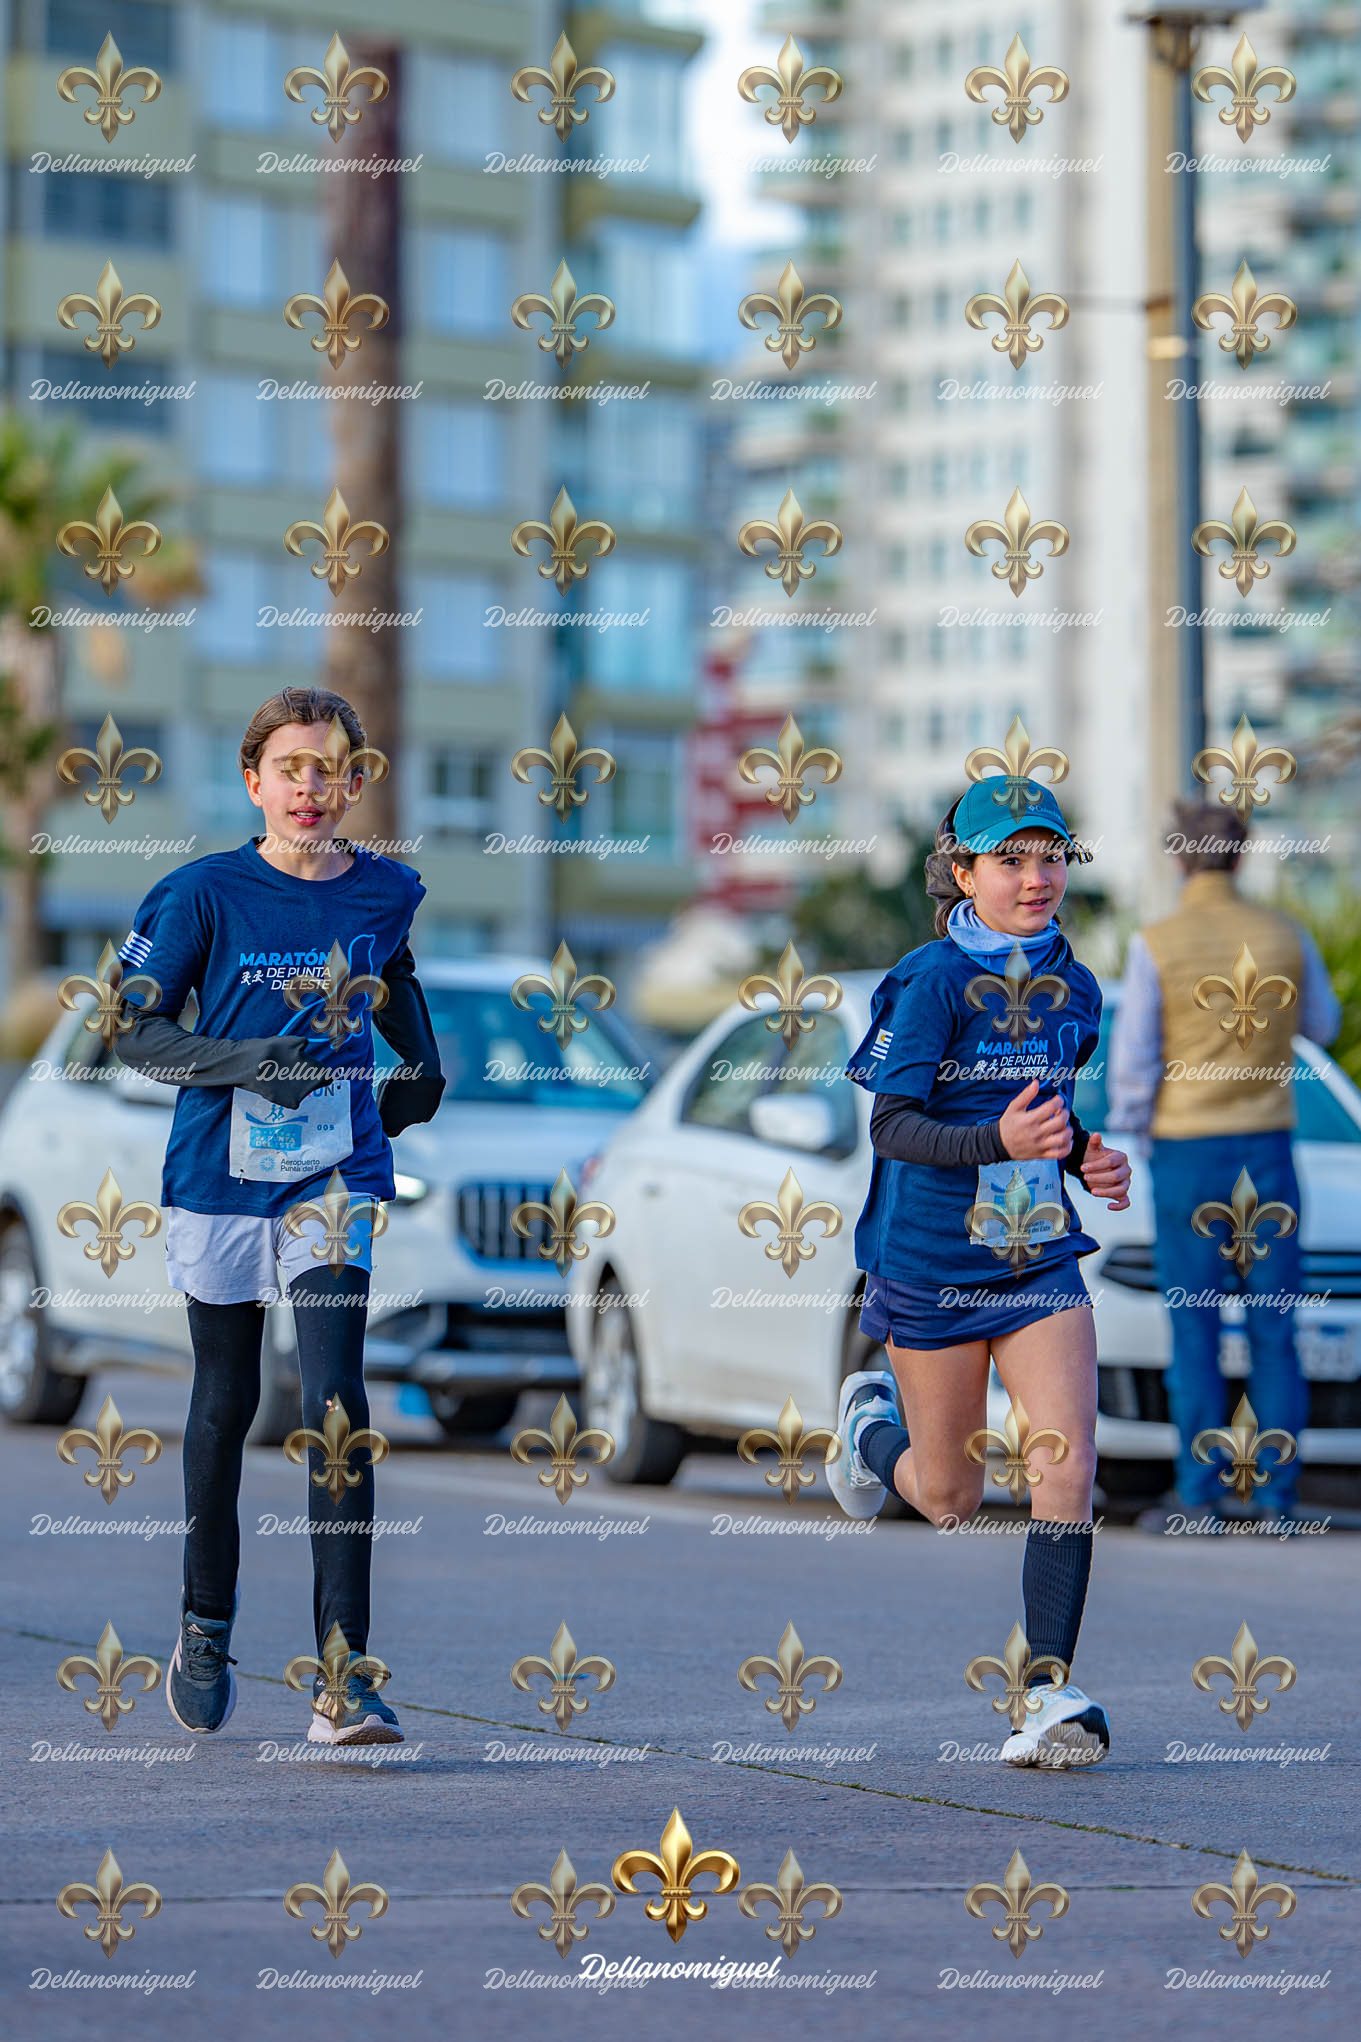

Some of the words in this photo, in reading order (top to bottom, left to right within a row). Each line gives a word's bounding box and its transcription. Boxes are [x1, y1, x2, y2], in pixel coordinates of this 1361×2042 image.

[239, 948, 332, 967] MARATÓN
[266, 966, 287, 978] DE
[287, 966, 332, 978] PUNTA
[271, 979, 297, 991] DEL
[299, 979, 332, 991] ESTE
[976, 1037, 1049, 1055] MARATÓN
[1000, 1055, 1013, 1067] DE
[1014, 1054, 1049, 1066] PUNTA
[306, 1083, 335, 1098] UN
